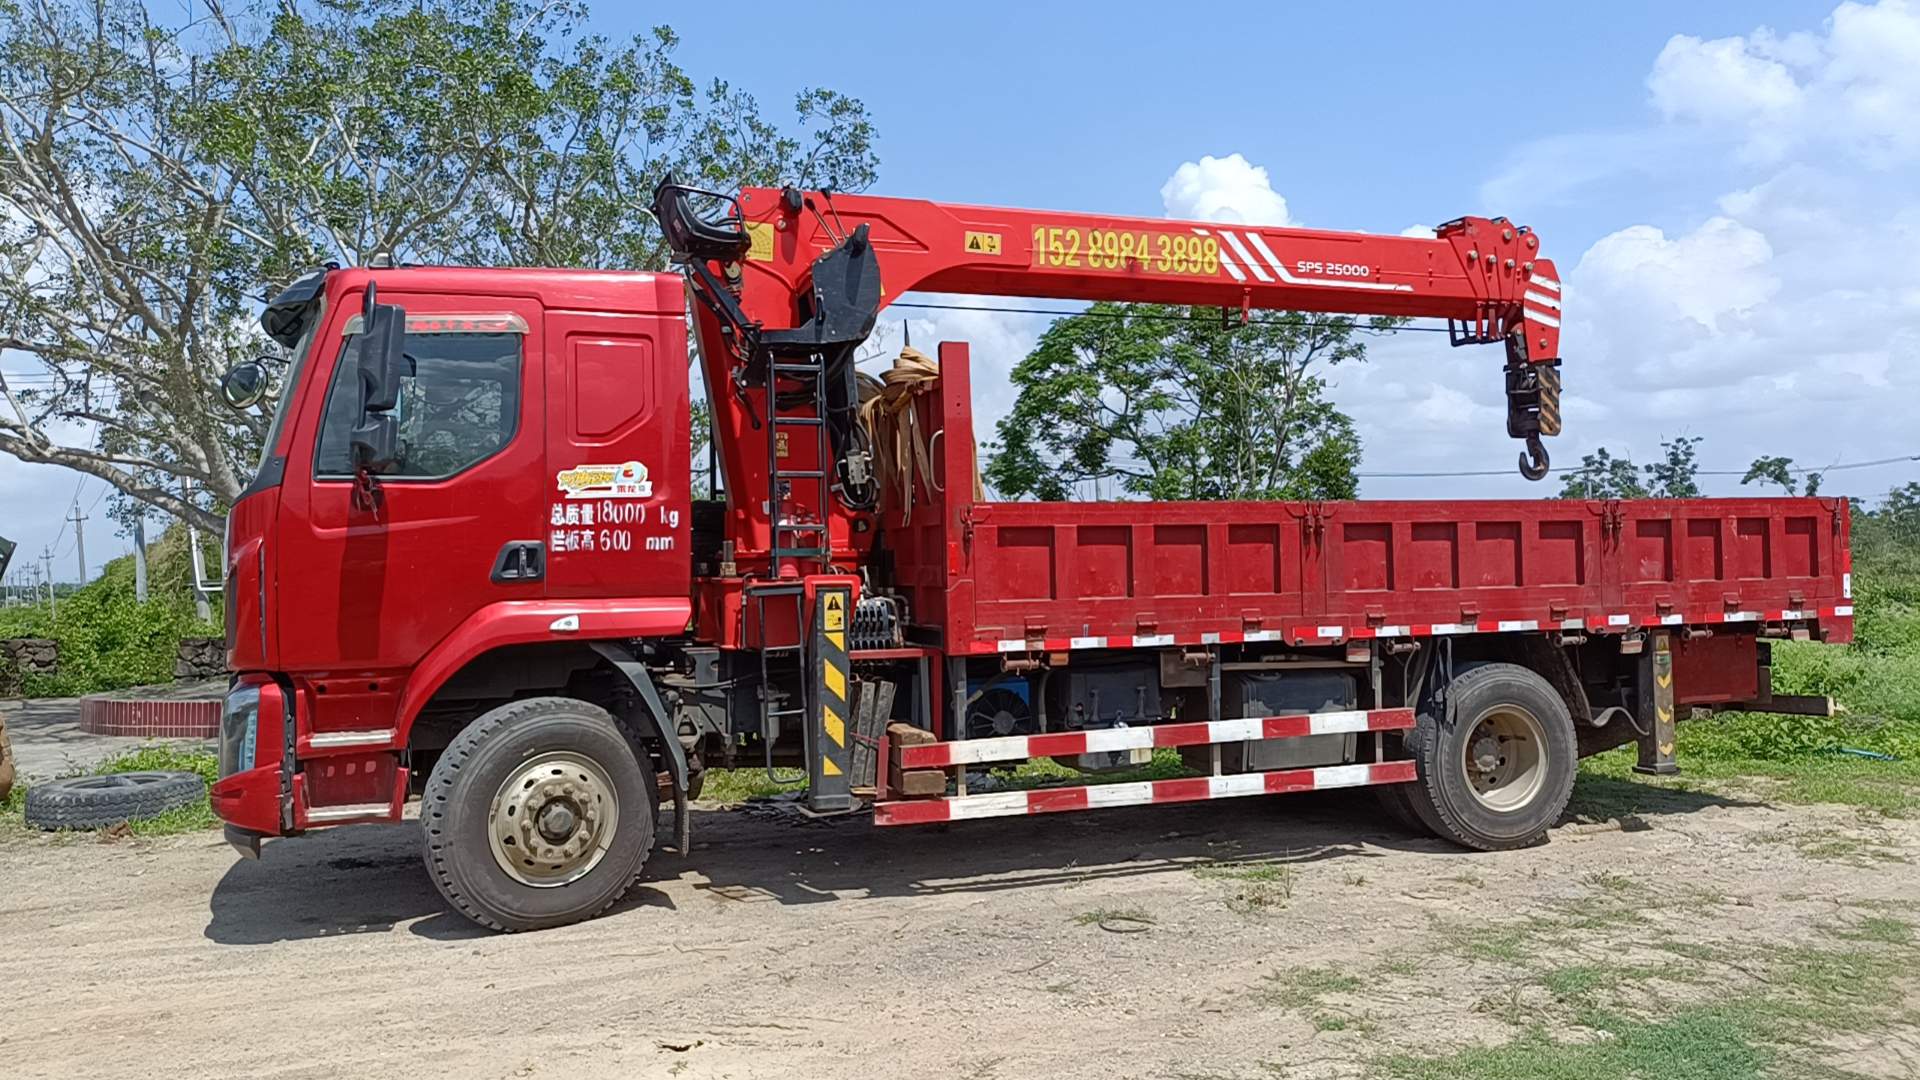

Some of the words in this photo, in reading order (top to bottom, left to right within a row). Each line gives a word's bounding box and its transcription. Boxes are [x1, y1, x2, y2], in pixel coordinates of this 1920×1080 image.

[1034, 227, 1081, 267] 152
[1088, 230, 1150, 271] 8984
[1157, 234, 1218, 274] 3898
[1297, 261, 1323, 274] SPS
[1326, 262, 1370, 277] 25000
[551, 503, 595, 525] 总质量
[660, 505, 680, 528] kg
[600, 529, 631, 551] 600
[645, 536, 675, 551] mm
